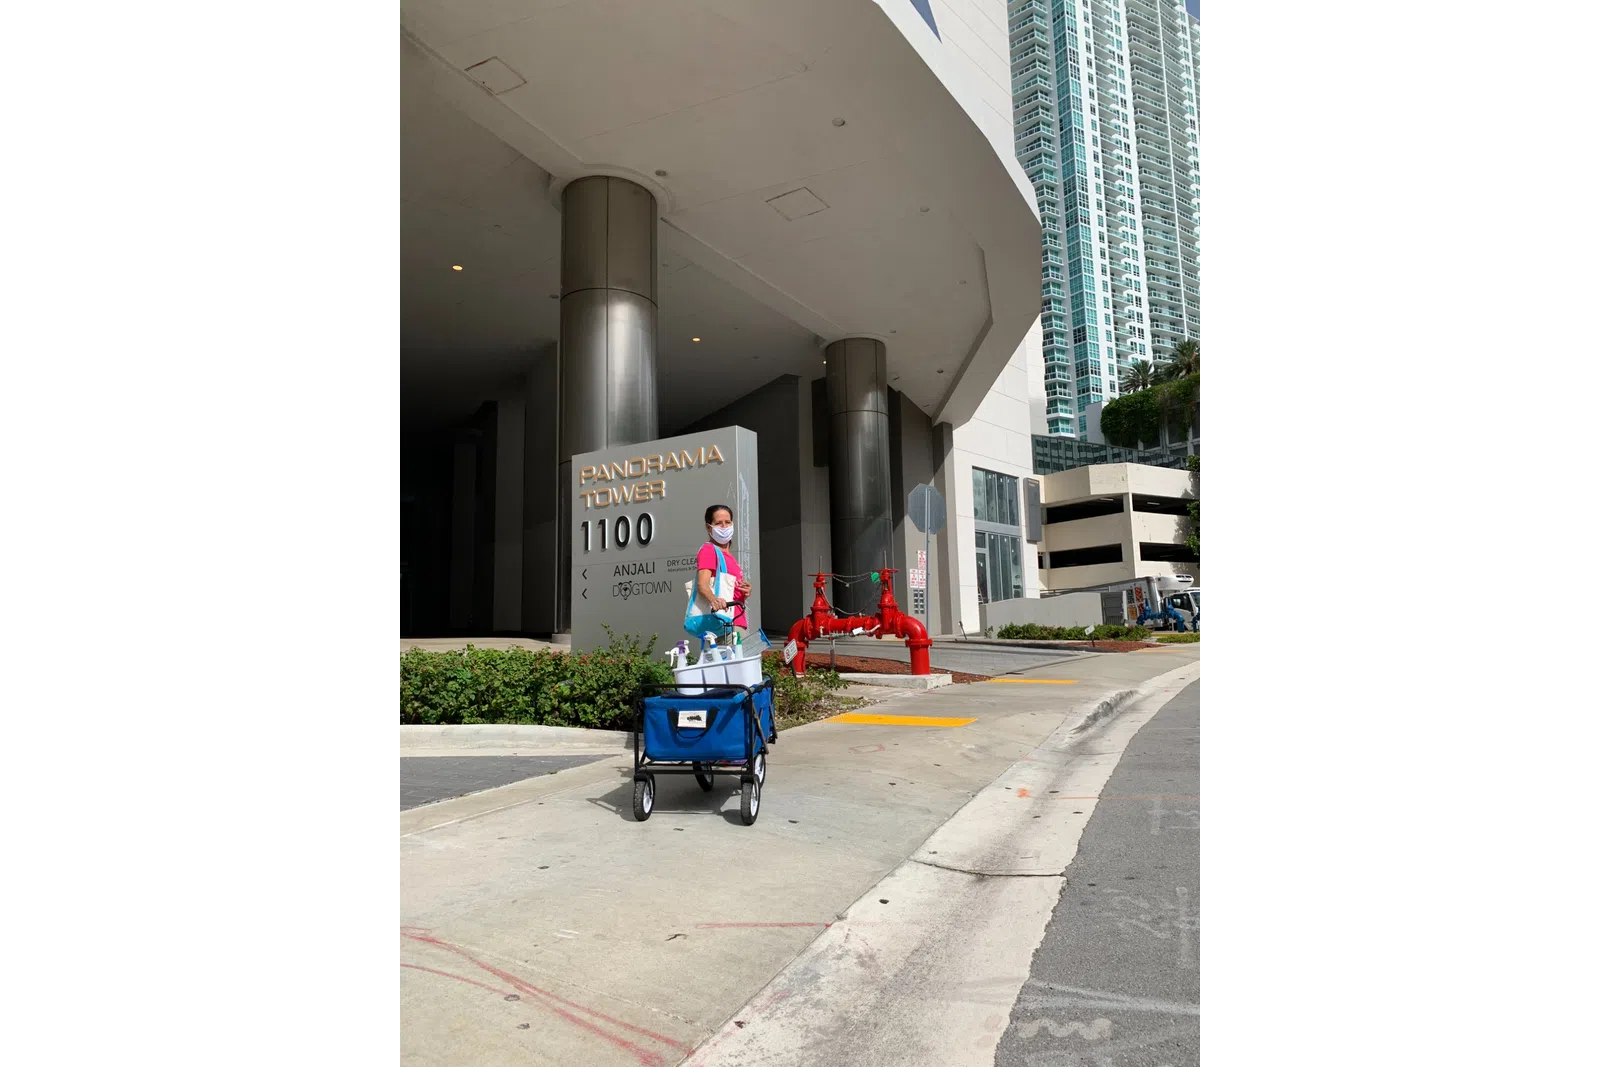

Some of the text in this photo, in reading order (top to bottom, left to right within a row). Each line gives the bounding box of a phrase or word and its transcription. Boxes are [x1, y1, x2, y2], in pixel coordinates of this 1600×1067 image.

[580, 445, 724, 485] PANORAMA
[580, 480, 666, 508] TOWER
[581, 512, 654, 551] 1100
[613, 561, 656, 577] ANJALI
[666, 560, 681, 568] DRY
